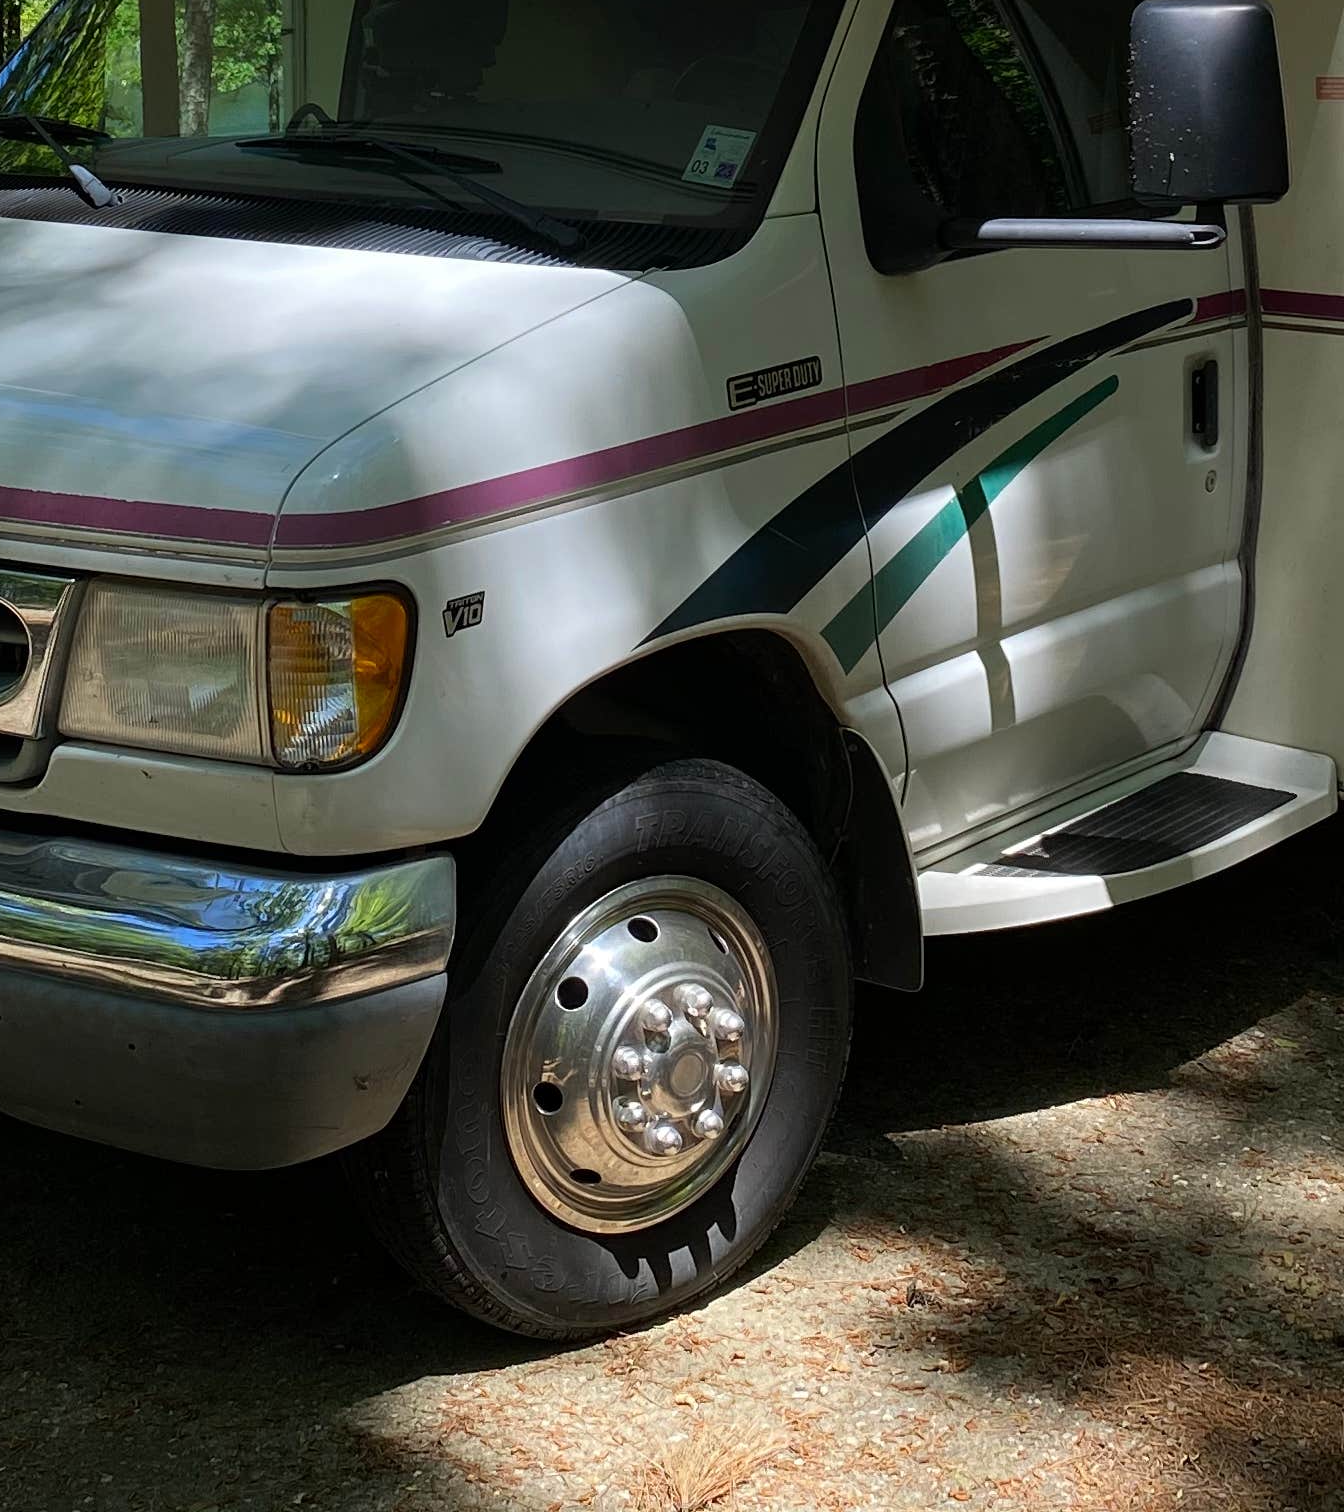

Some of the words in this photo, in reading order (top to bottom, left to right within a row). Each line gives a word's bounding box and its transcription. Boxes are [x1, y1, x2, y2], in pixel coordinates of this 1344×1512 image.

[691, 159, 710, 175] 03
[758, 368, 792, 397] SUPER
[793, 360, 821, 387] DUTY
[443, 603, 482, 636] V10
